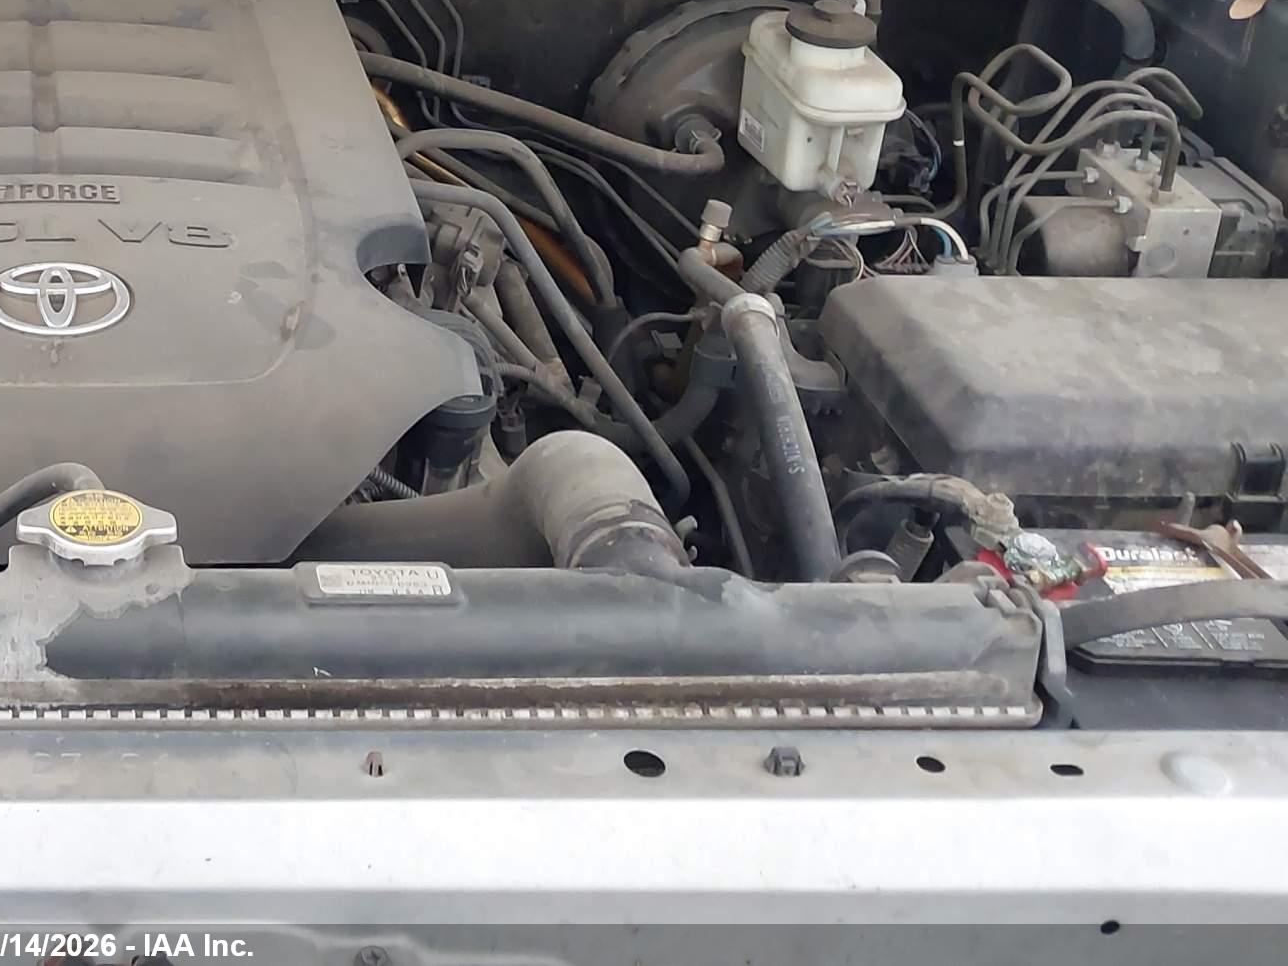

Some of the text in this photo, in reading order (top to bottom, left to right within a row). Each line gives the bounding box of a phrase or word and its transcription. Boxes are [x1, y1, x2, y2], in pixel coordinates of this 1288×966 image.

[97, 218, 234, 249] V8
[1096, 545, 1199, 563] Duralast
[349, 568, 420, 577] TOYOTA
